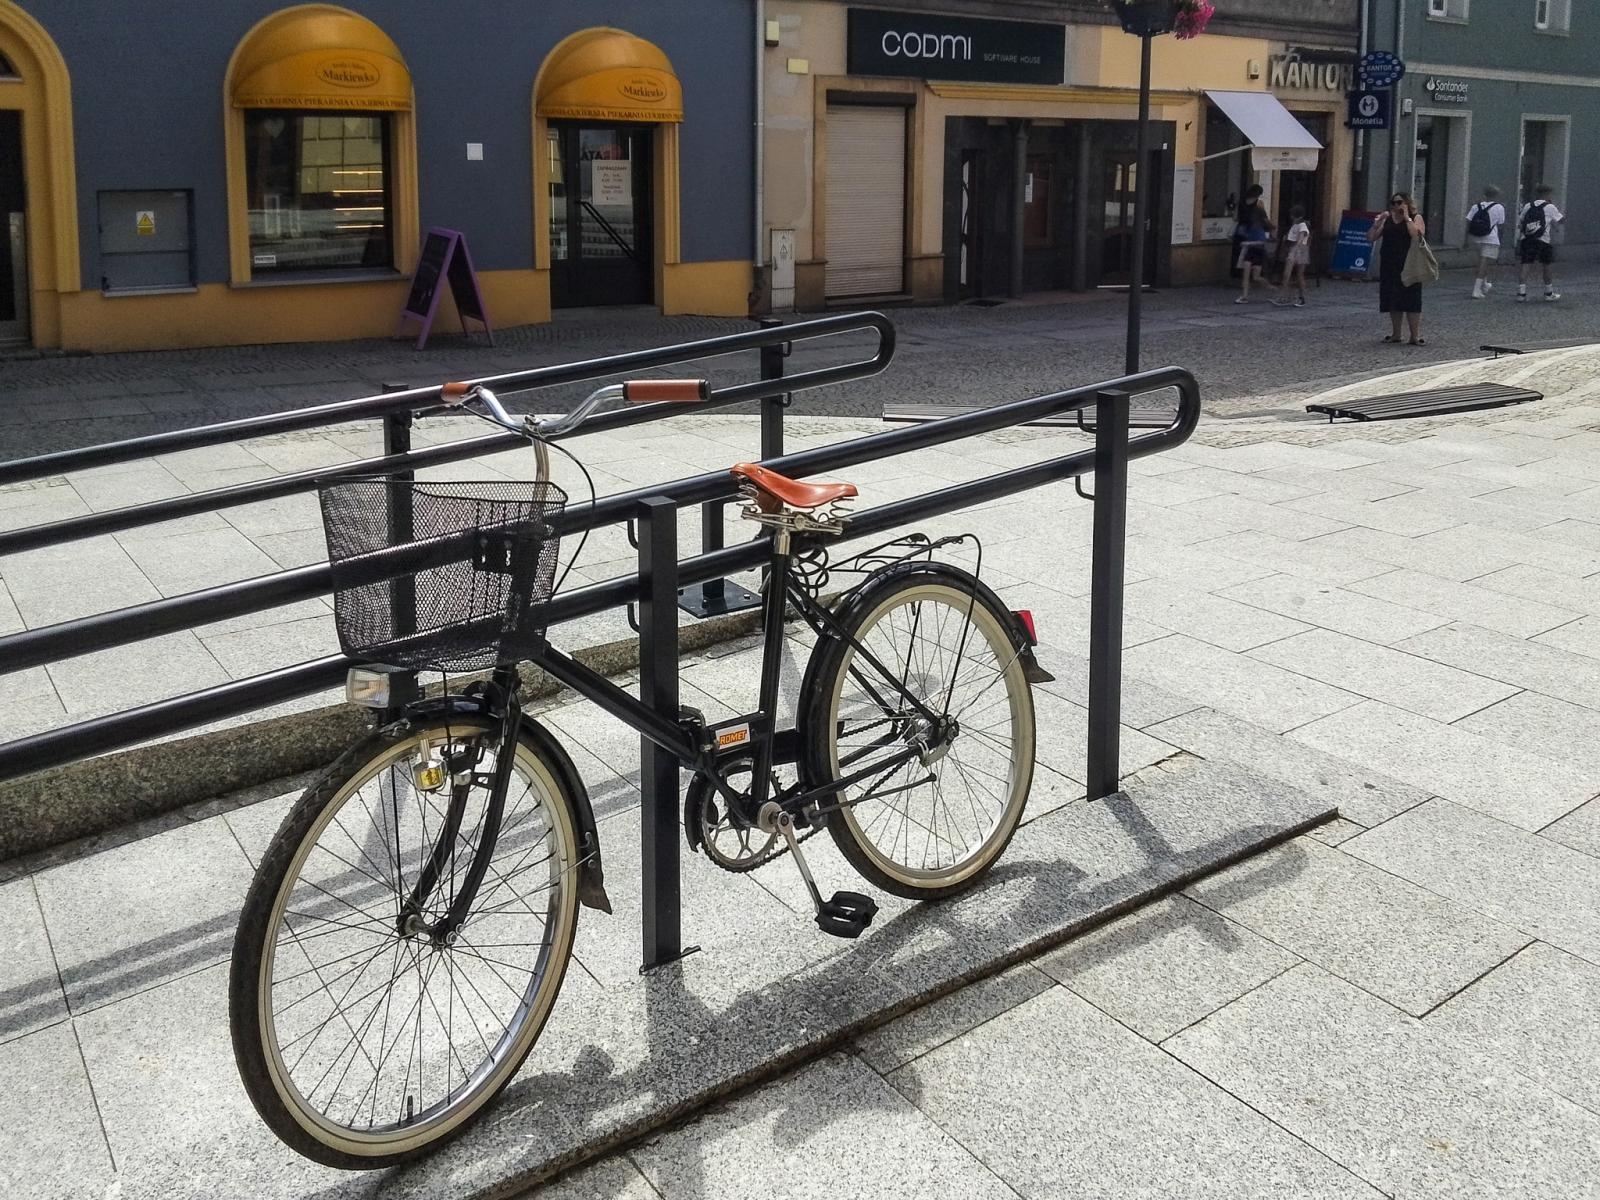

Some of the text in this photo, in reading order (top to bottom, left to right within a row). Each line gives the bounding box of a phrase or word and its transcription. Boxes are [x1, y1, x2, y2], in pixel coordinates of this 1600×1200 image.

[983, 53, 1041, 64] SOFTWARE HOUSE
[1366, 64, 1392, 72] KANTOR
[1270, 60, 1357, 91] KANTOR
[1435, 79, 1469, 93] Santander
[1456, 94, 1468, 103] Bank
[1351, 117, 1384, 126] Monetia
[719, 729, 748, 746] ROMET
